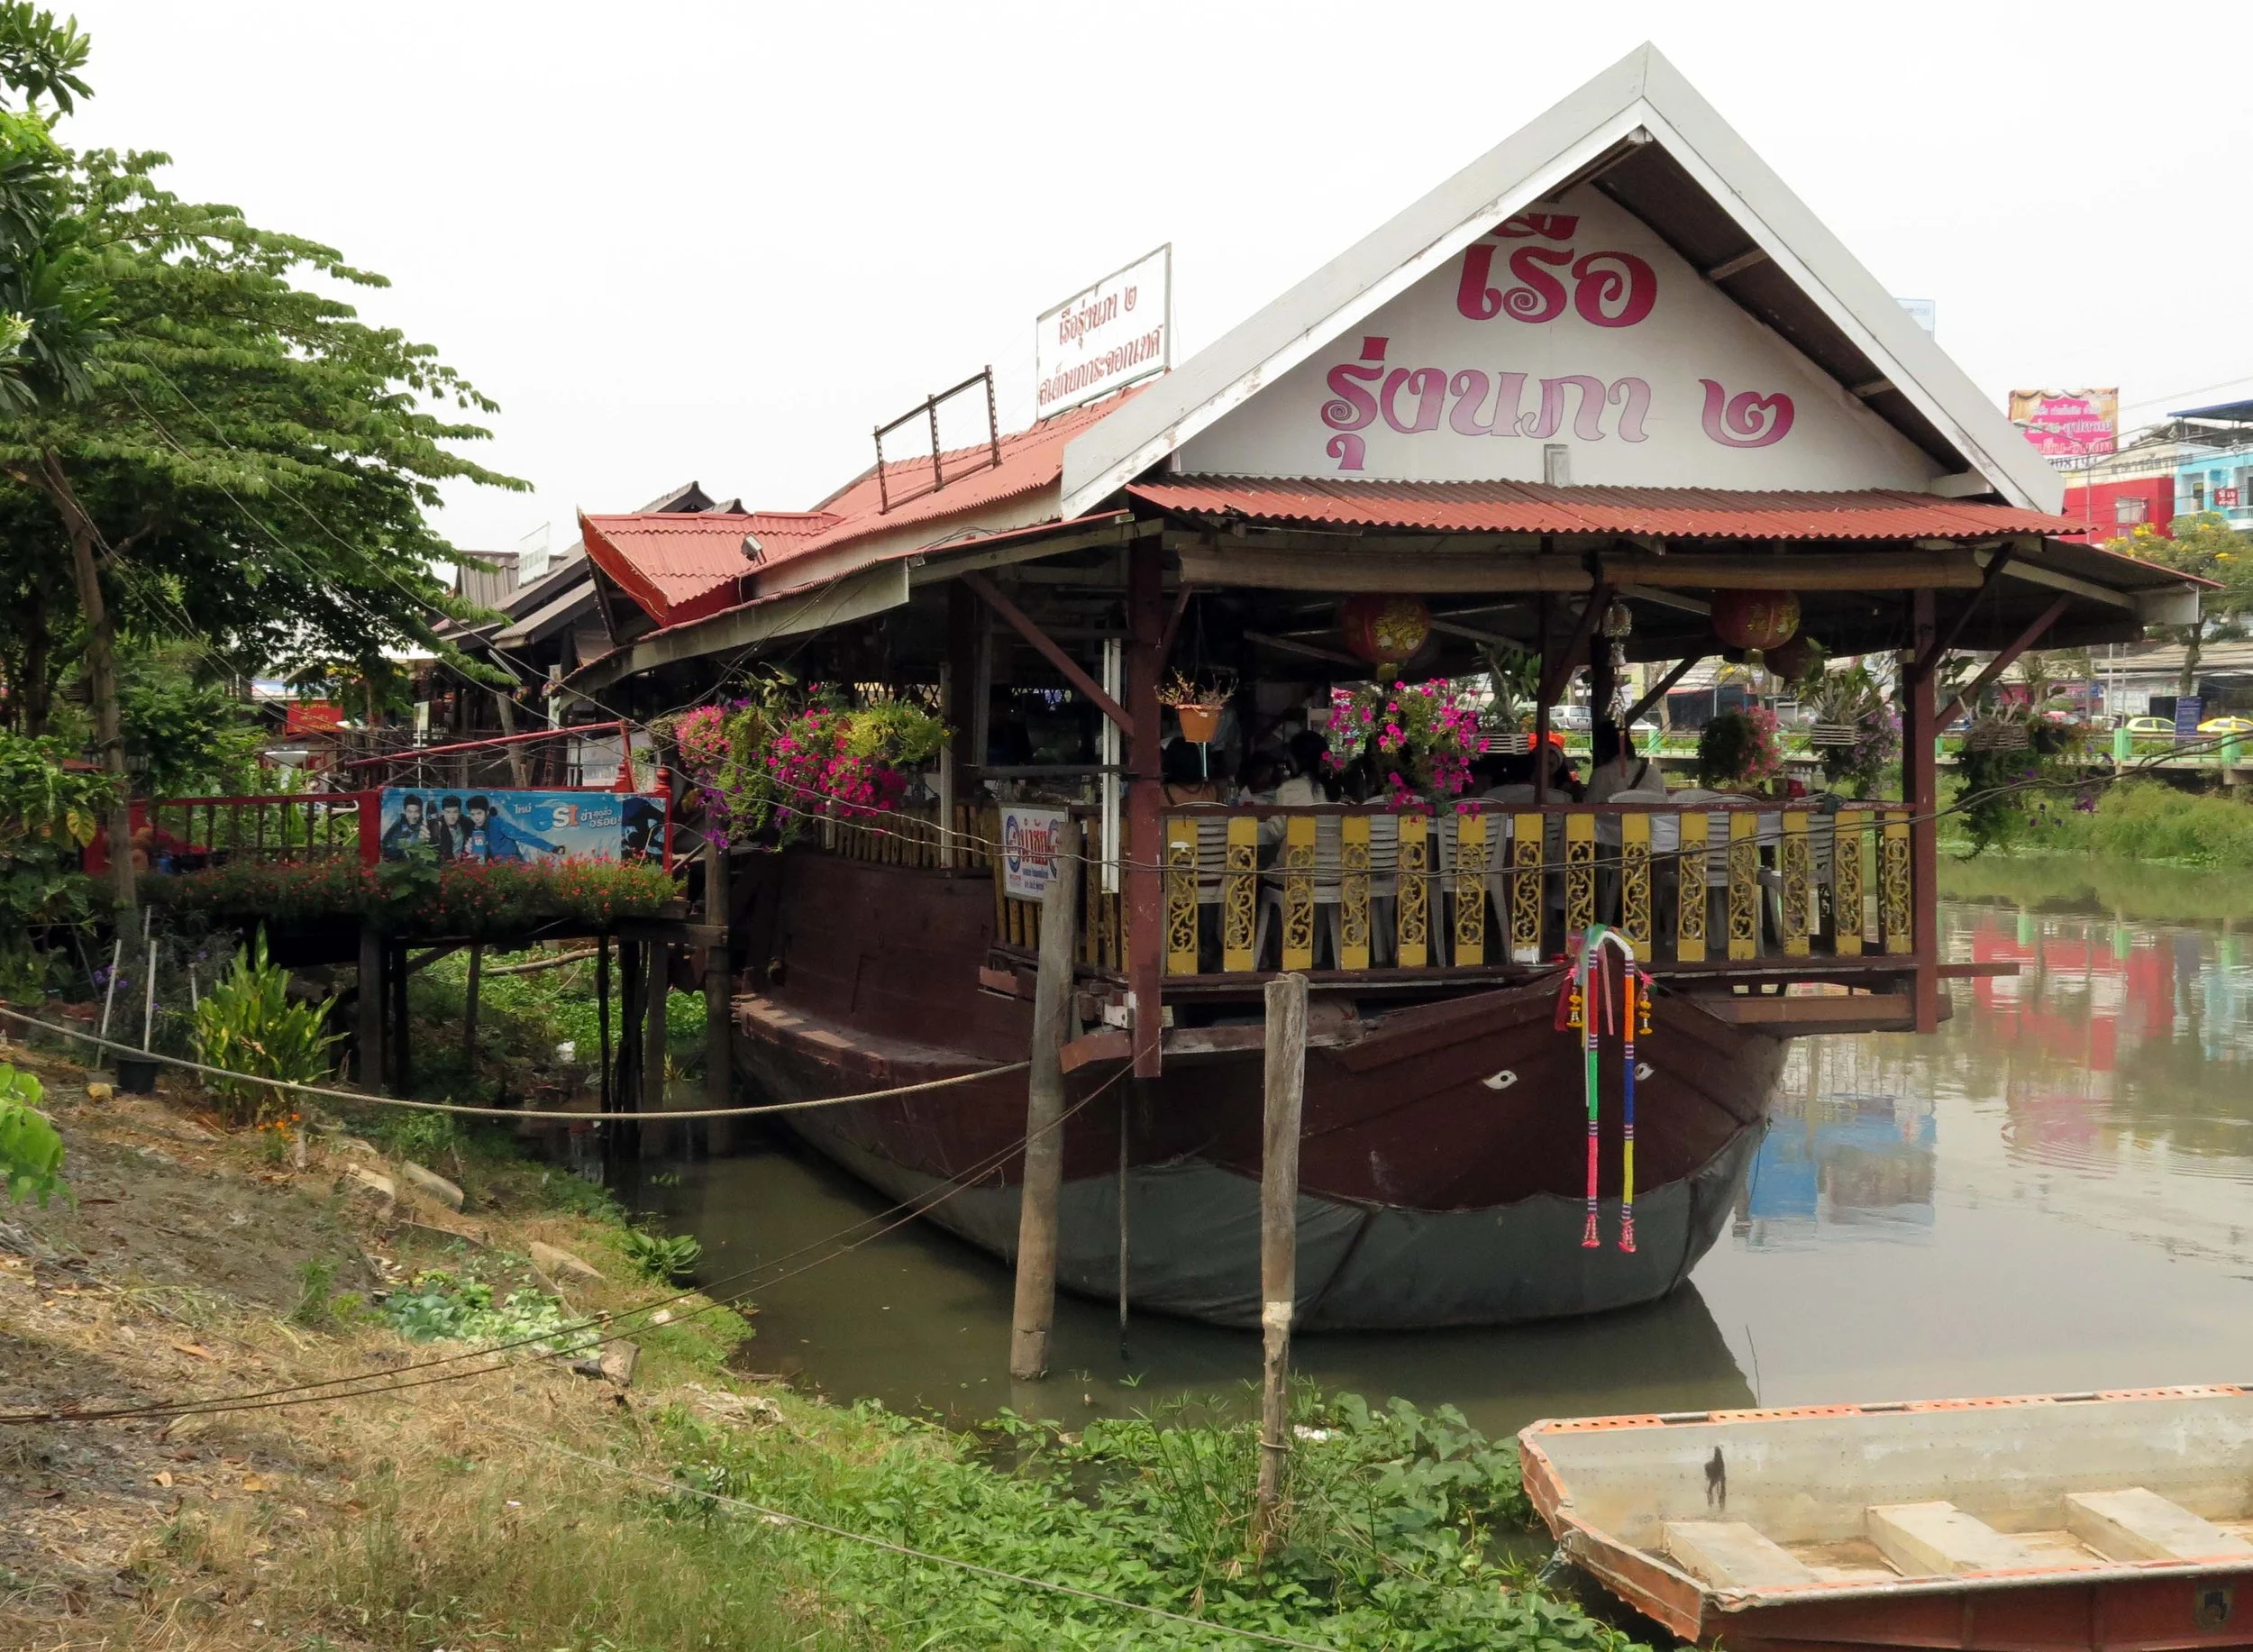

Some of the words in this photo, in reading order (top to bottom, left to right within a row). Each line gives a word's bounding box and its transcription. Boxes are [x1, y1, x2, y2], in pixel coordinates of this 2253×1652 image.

[1456, 213, 1658, 328] เรือ
[1319, 335, 1652, 470] รุ่งนภา
[1698, 378, 1796, 449] ๒
